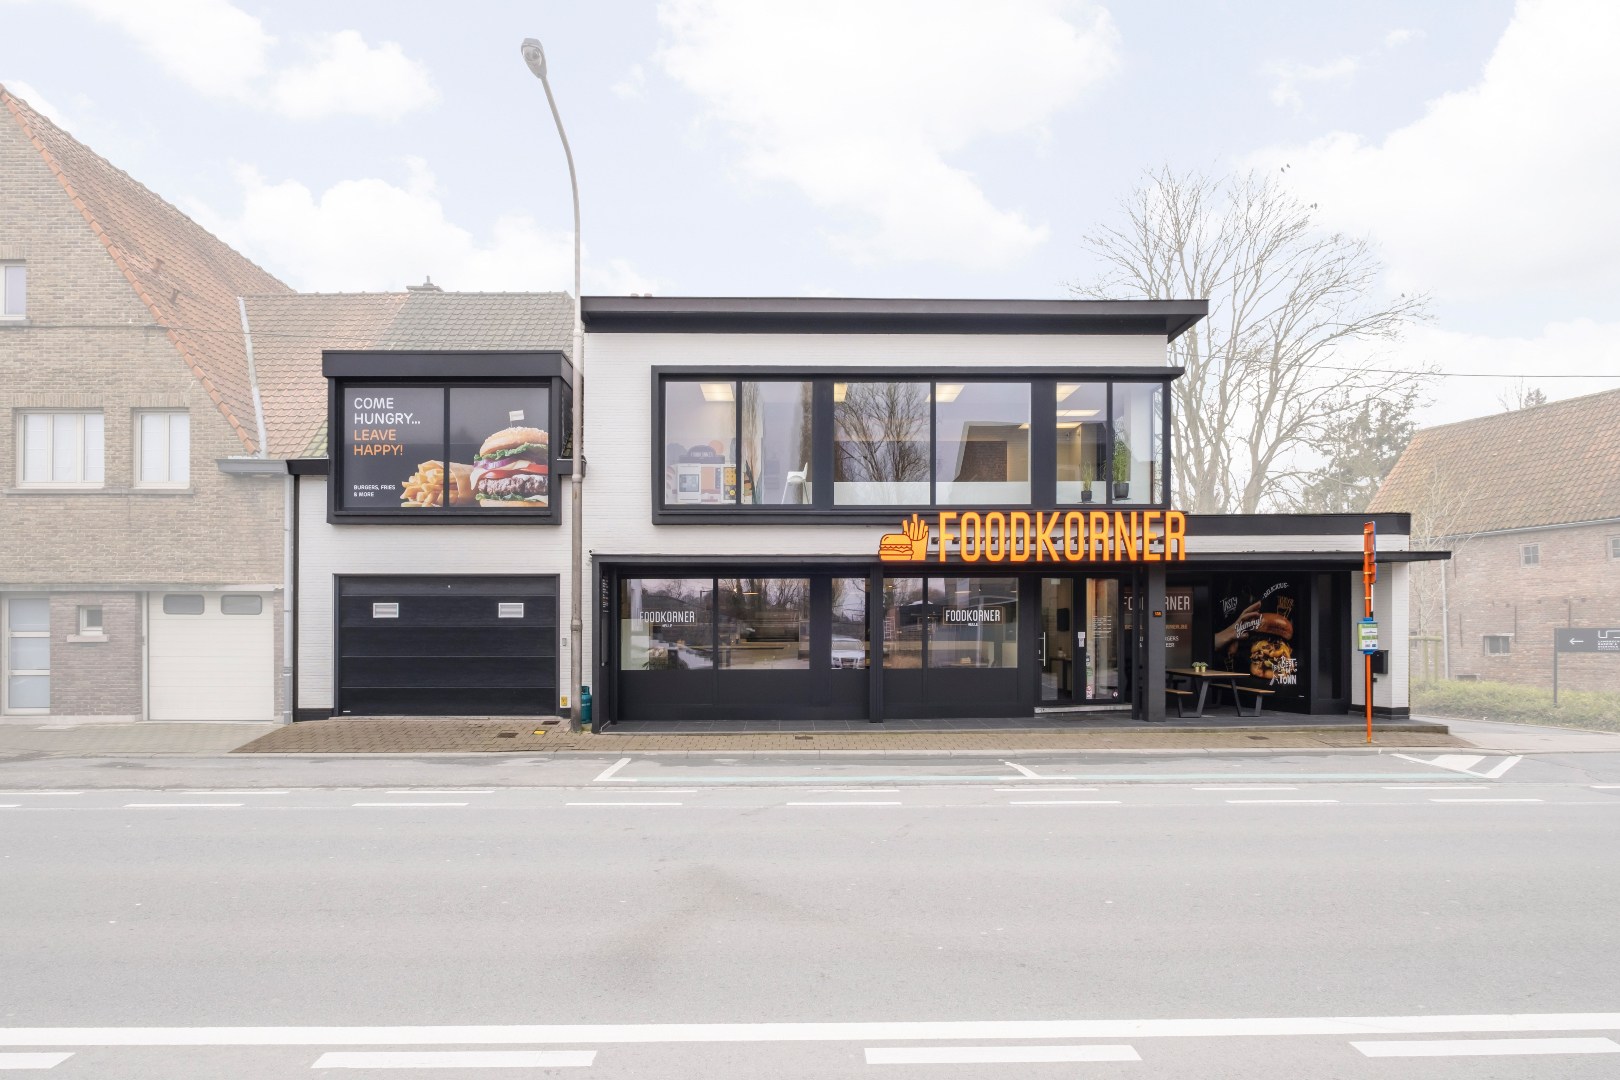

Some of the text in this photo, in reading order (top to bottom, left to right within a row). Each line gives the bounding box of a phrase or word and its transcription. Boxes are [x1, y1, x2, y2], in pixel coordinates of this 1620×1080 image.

[354, 397, 394, 409] COME
[354, 412, 421, 425] HUNGRY...
[354, 429, 397, 441] LEAVE
[353, 444, 403, 456] HAPPY!
[938, 511, 1186, 562] FOODKORNER
[639, 610, 695, 623] FOODKORNER
[945, 609, 1001, 622] FOODKORNER
